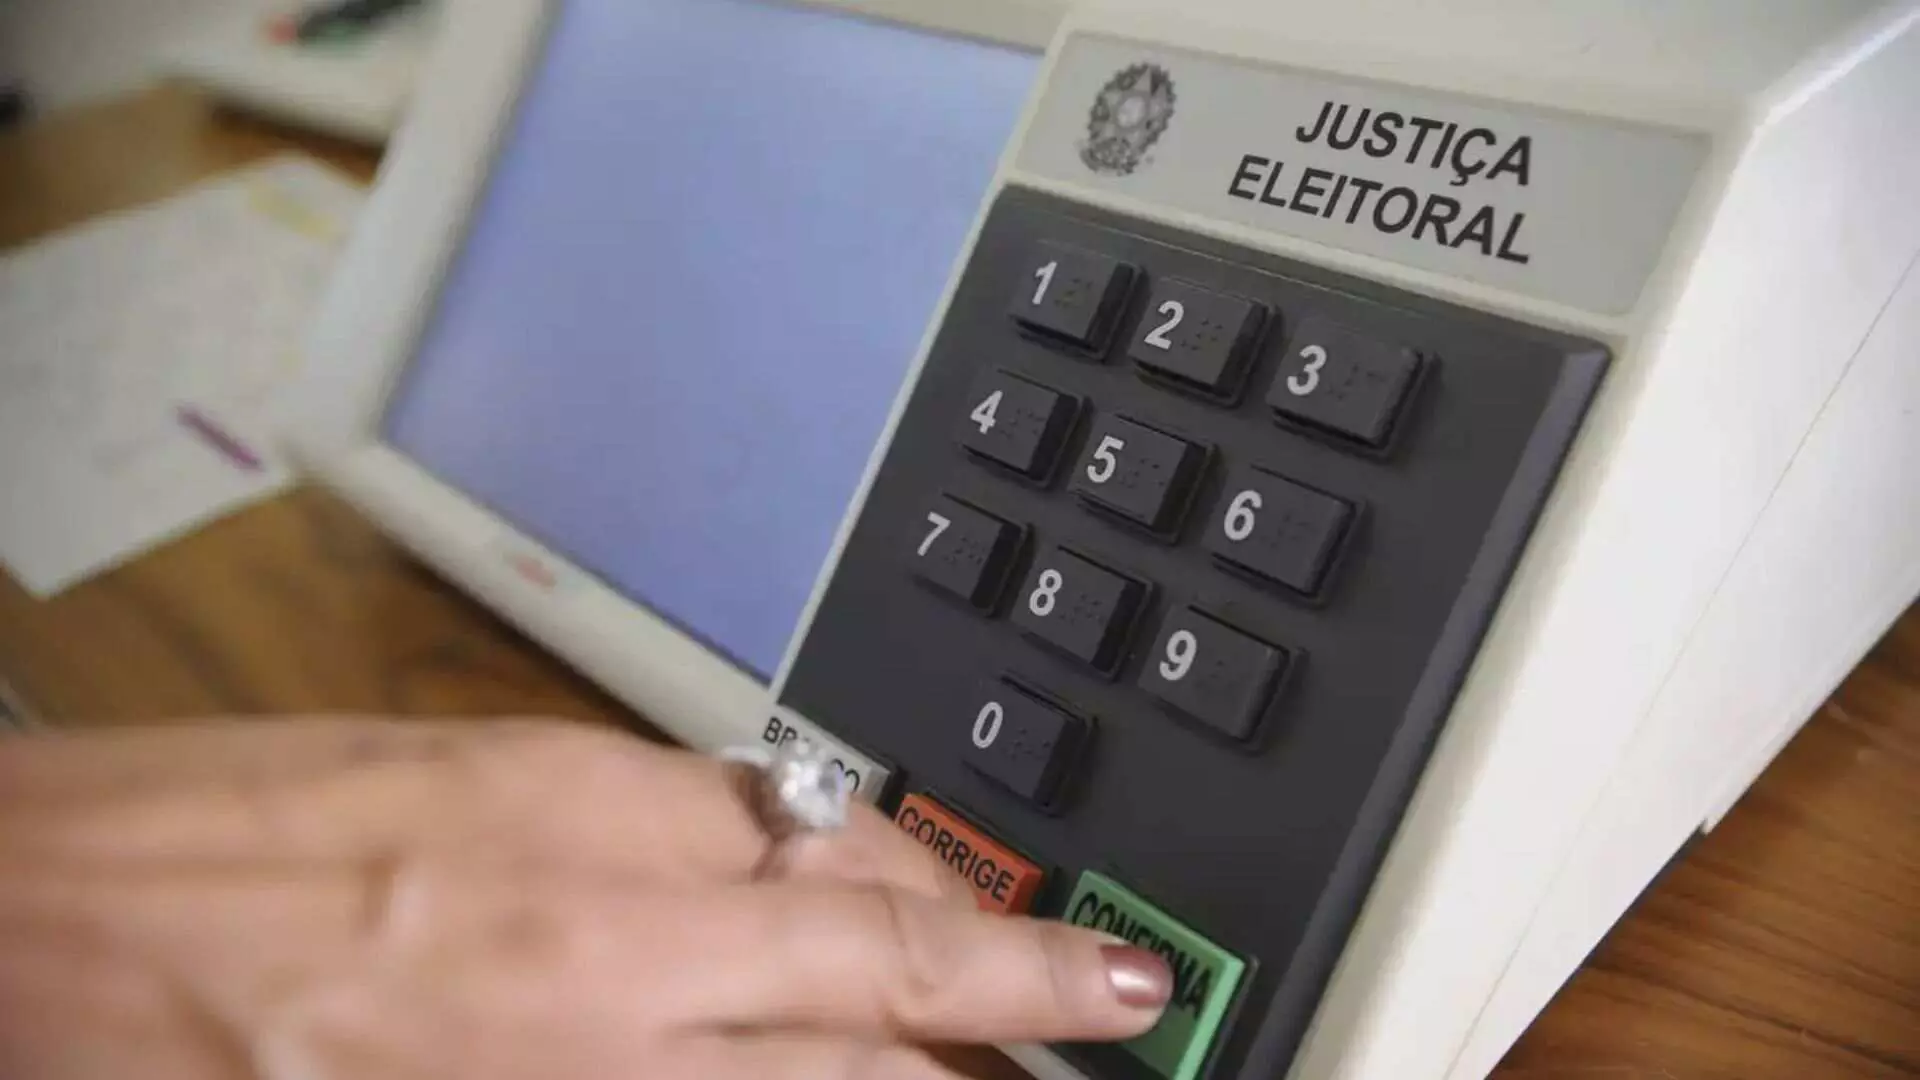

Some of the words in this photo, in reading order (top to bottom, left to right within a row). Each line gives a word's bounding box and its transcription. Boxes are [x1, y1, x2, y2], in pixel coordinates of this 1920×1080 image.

[1296, 101, 1532, 187] JUSTIÇA
[1228, 154, 1532, 264] ELEITORAL
[1031, 260, 1058, 305] 1
[1144, 300, 1184, 350] 2
[1286, 344, 1327, 396] 3
[970, 390, 1003, 434] 4
[1086, 435, 1125, 484] 5
[917, 512, 950, 556] 7
[1223, 489, 1263, 541] 6
[1029, 569, 1063, 616] 8
[1159, 629, 1198, 681] 9
[972, 701, 1004, 749] 0
[899, 806, 1016, 904] CORRIGE
